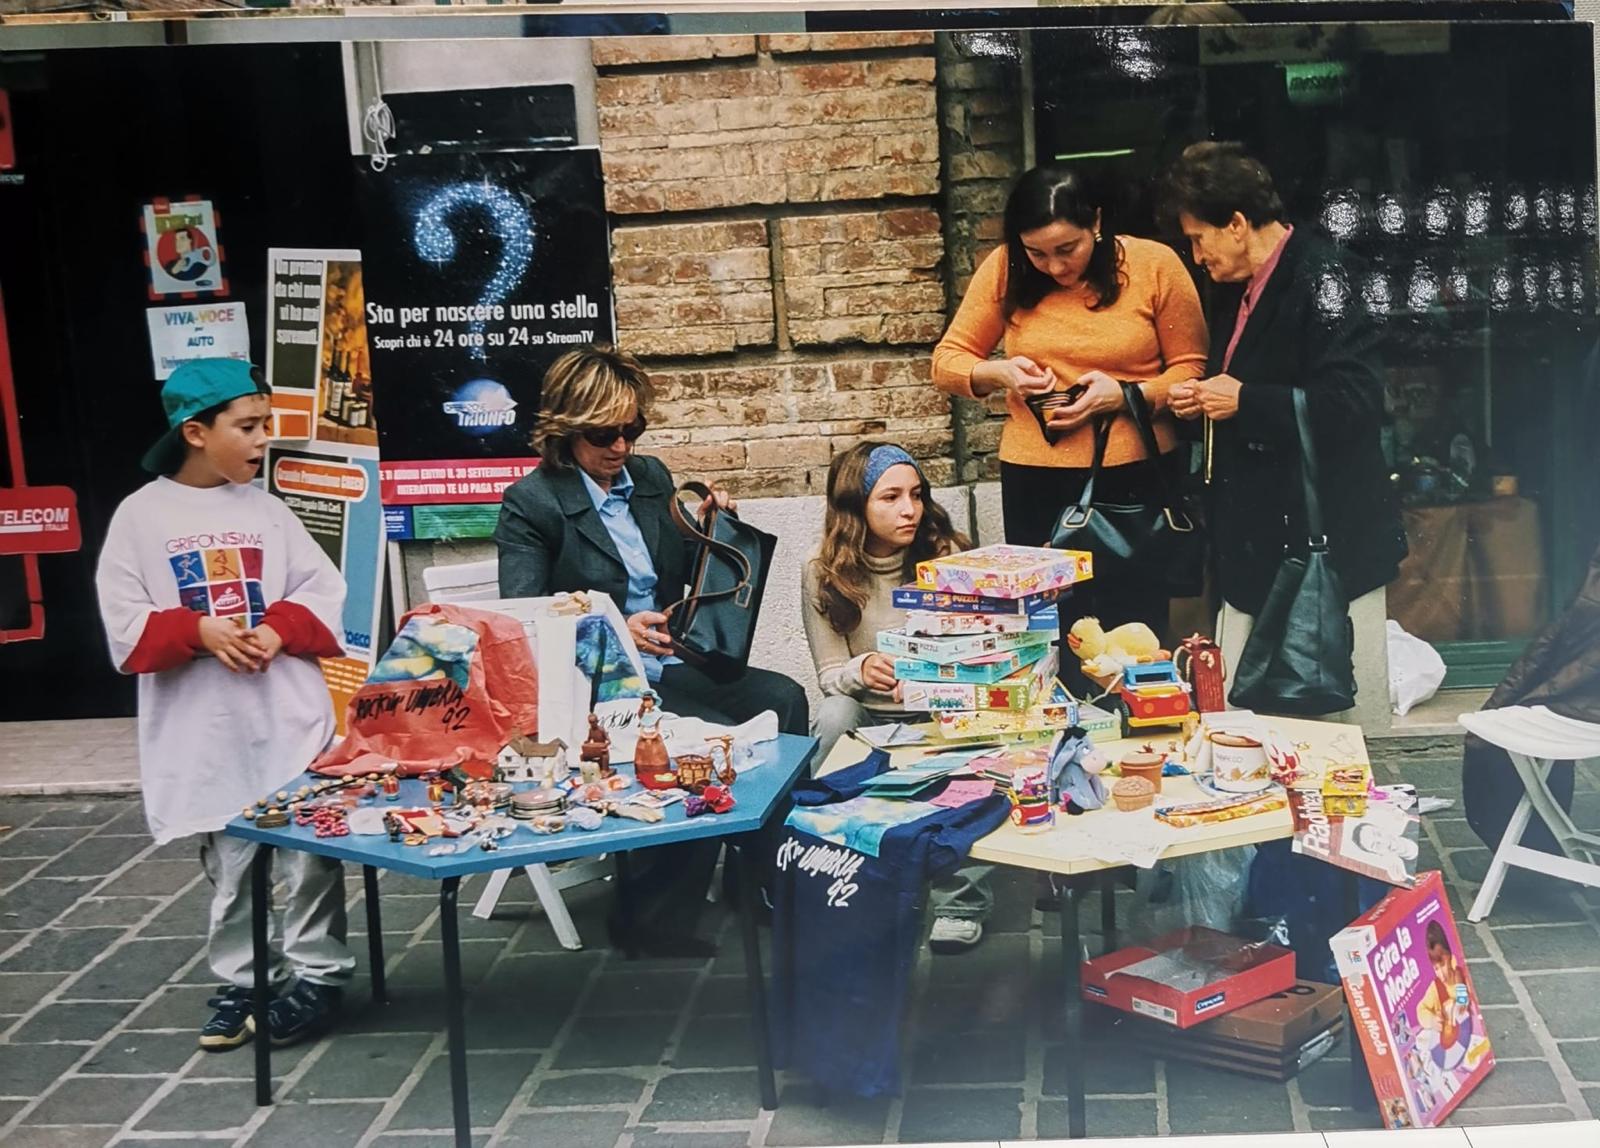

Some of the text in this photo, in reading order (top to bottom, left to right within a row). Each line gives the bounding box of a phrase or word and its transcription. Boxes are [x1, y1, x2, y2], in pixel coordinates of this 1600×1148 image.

[366, 294, 599, 328] Sta per nascere una stella
[187, 335, 215, 348] AUTO
[374, 326, 594, 351] Scopri chi è 24 ore su 24 su StreamTV
[442, 707, 471, 734] 92
[1084, 720, 1114, 731] UZZLE
[827, 878, 859, 907] 92
[1374, 941, 1401, 981] Gira
[1395, 926, 1412, 954] la
[1348, 983, 1365, 1008] Gira
[1384, 956, 1420, 1014] Moda
[1359, 1006, 1371, 1021] la
[1364, 1019, 1388, 1056] Moda
